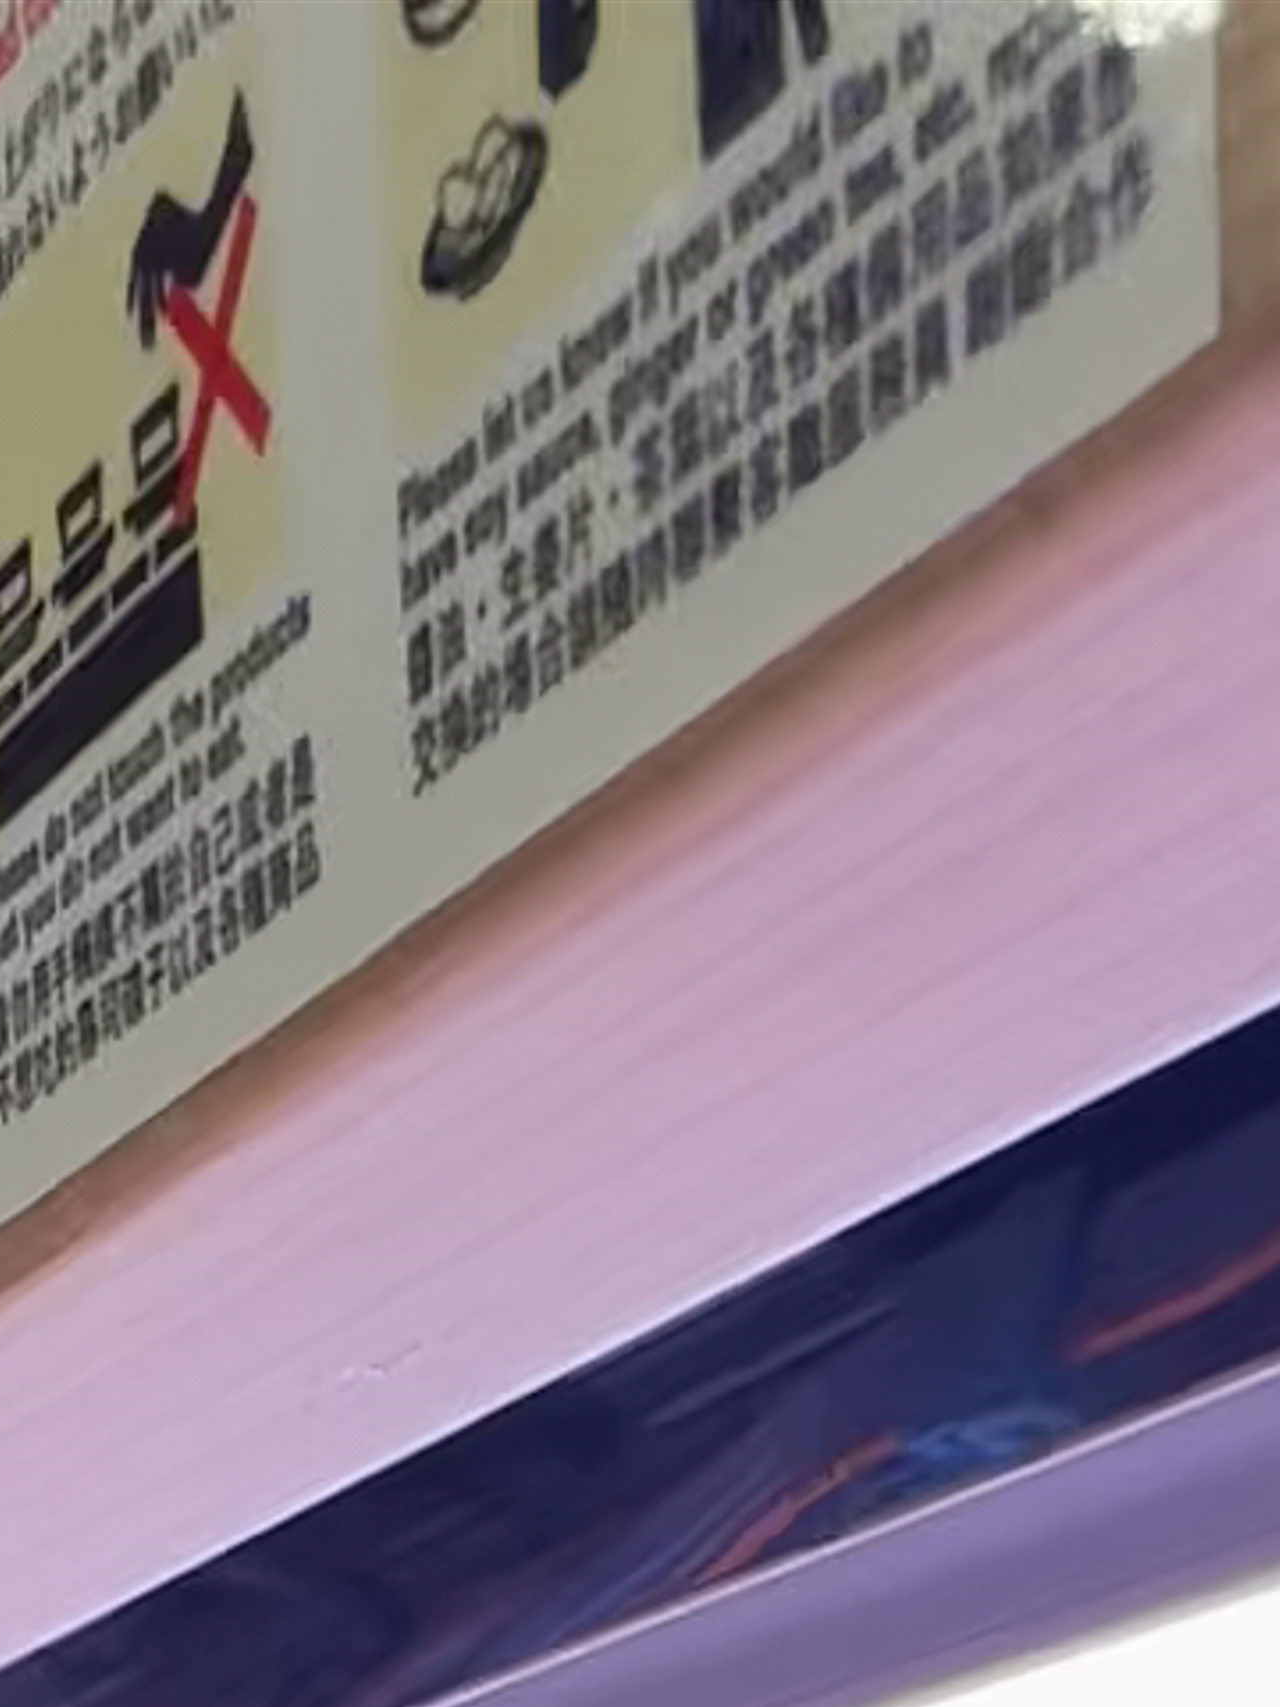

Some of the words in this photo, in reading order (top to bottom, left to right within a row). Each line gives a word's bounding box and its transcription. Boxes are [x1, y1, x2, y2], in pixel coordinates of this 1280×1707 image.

[397, 436, 477, 538] Please
[400, 530, 457, 610] have
[45, 813, 66, 864] do
[211, 591, 312, 726] products
